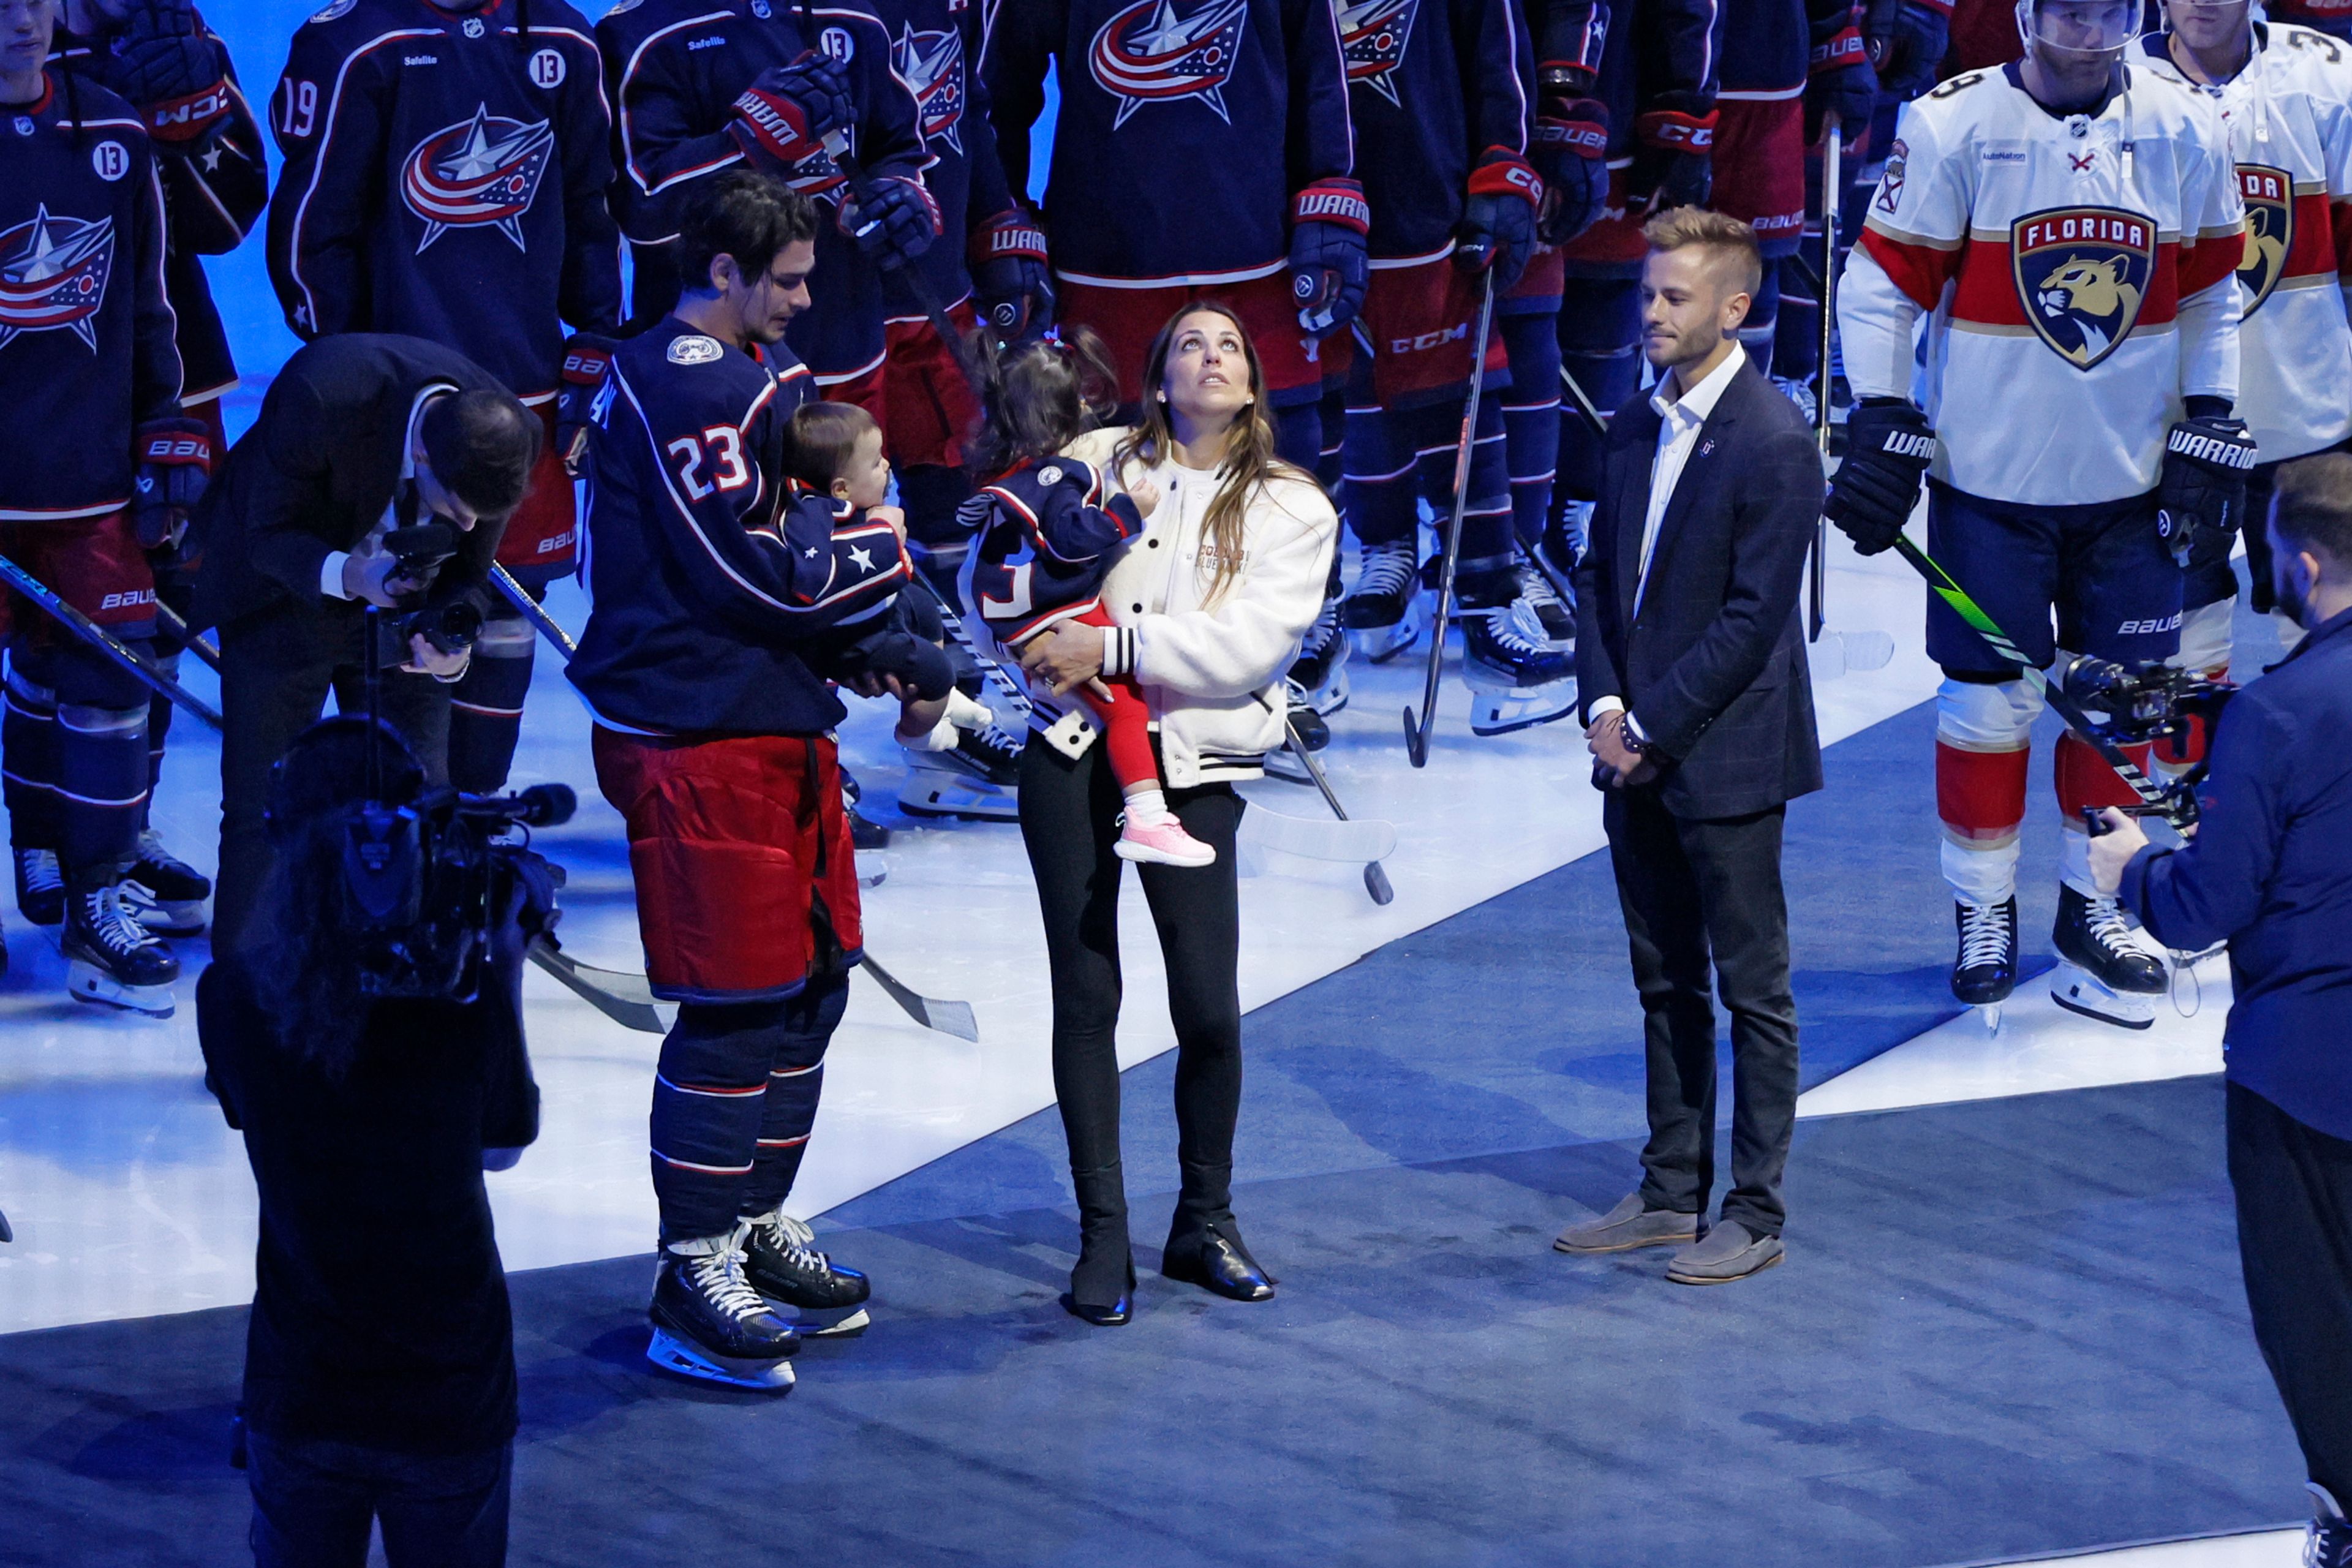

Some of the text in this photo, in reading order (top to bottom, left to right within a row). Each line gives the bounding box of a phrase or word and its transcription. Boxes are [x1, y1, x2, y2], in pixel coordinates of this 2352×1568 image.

[538, 55, 559, 83] 13
[282, 77, 316, 138] 19
[100, 147, 121, 175] 13
[1983, 153, 2026, 163] AutoNation
[2028, 219, 2143, 246] FLORIDA
[1392, 323, 1468, 353] CCM
[667, 426, 747, 500] 23
